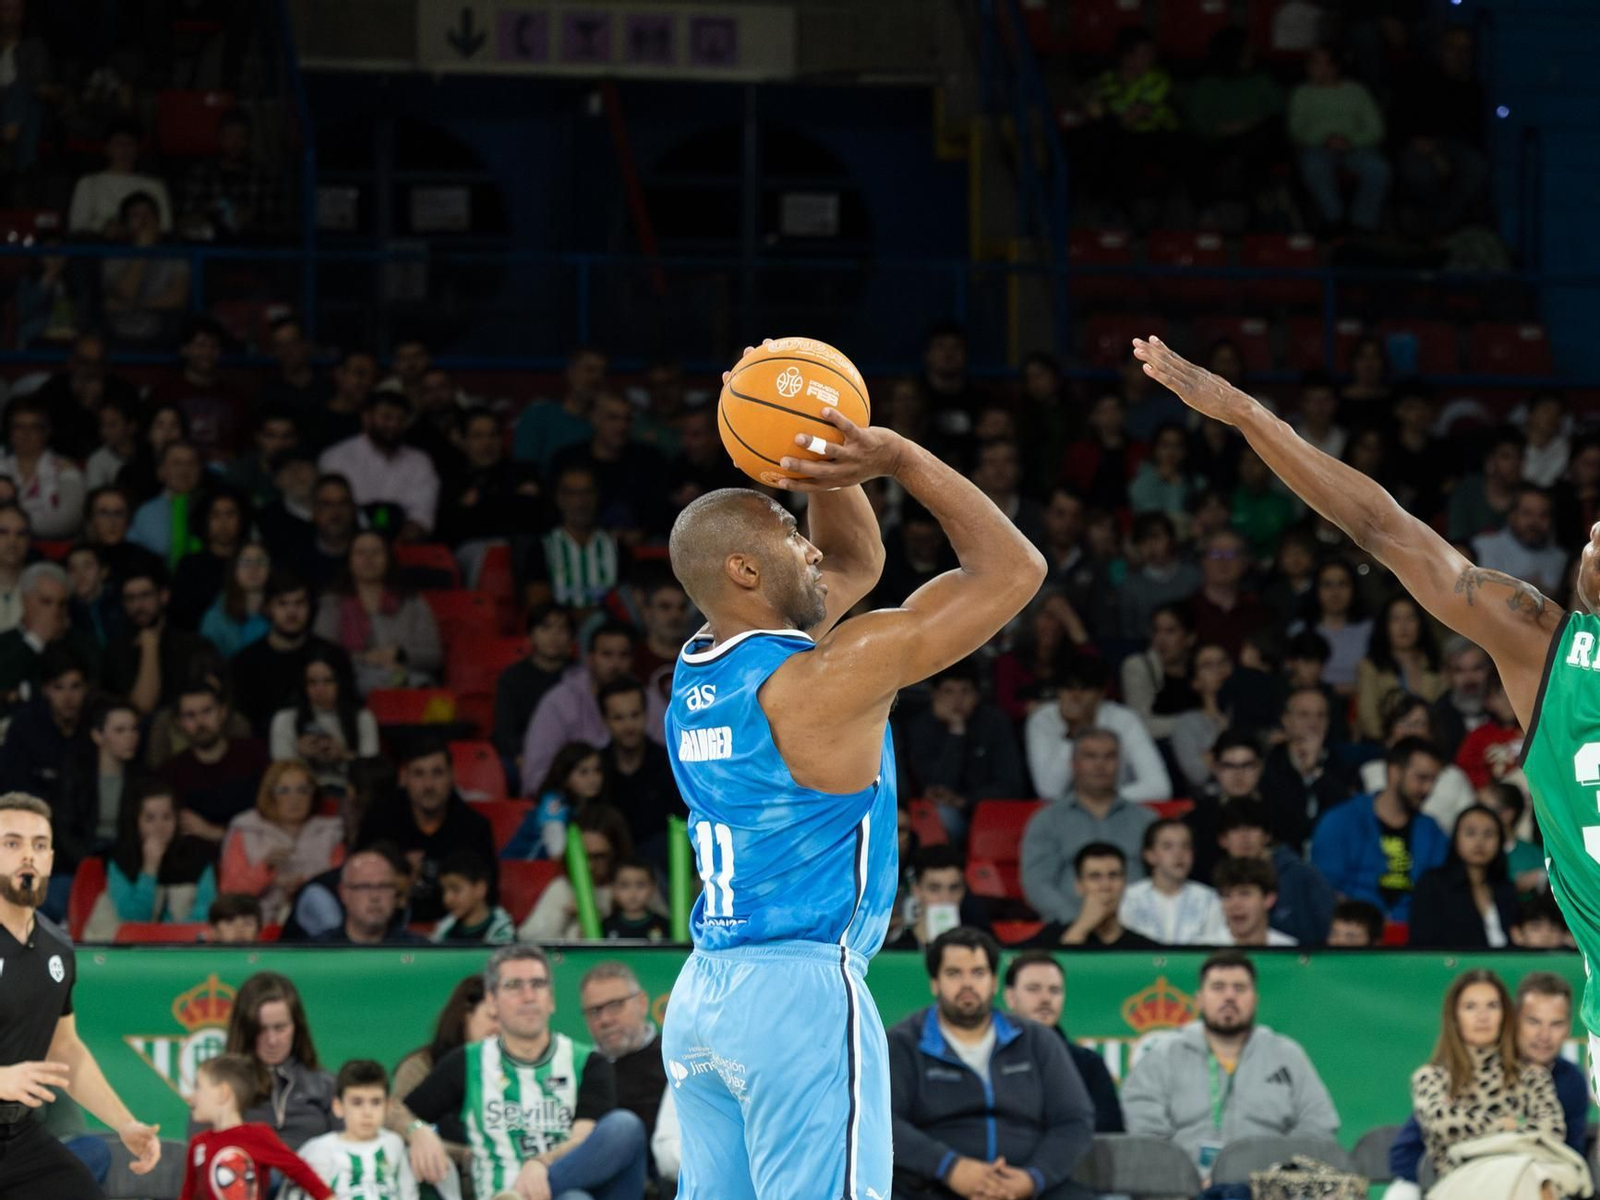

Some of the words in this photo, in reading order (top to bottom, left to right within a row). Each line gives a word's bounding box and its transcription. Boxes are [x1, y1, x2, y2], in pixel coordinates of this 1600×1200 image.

[686, 684, 717, 711] as
[695, 821, 735, 917] 11
[485, 1099, 572, 1123] Sevilla
